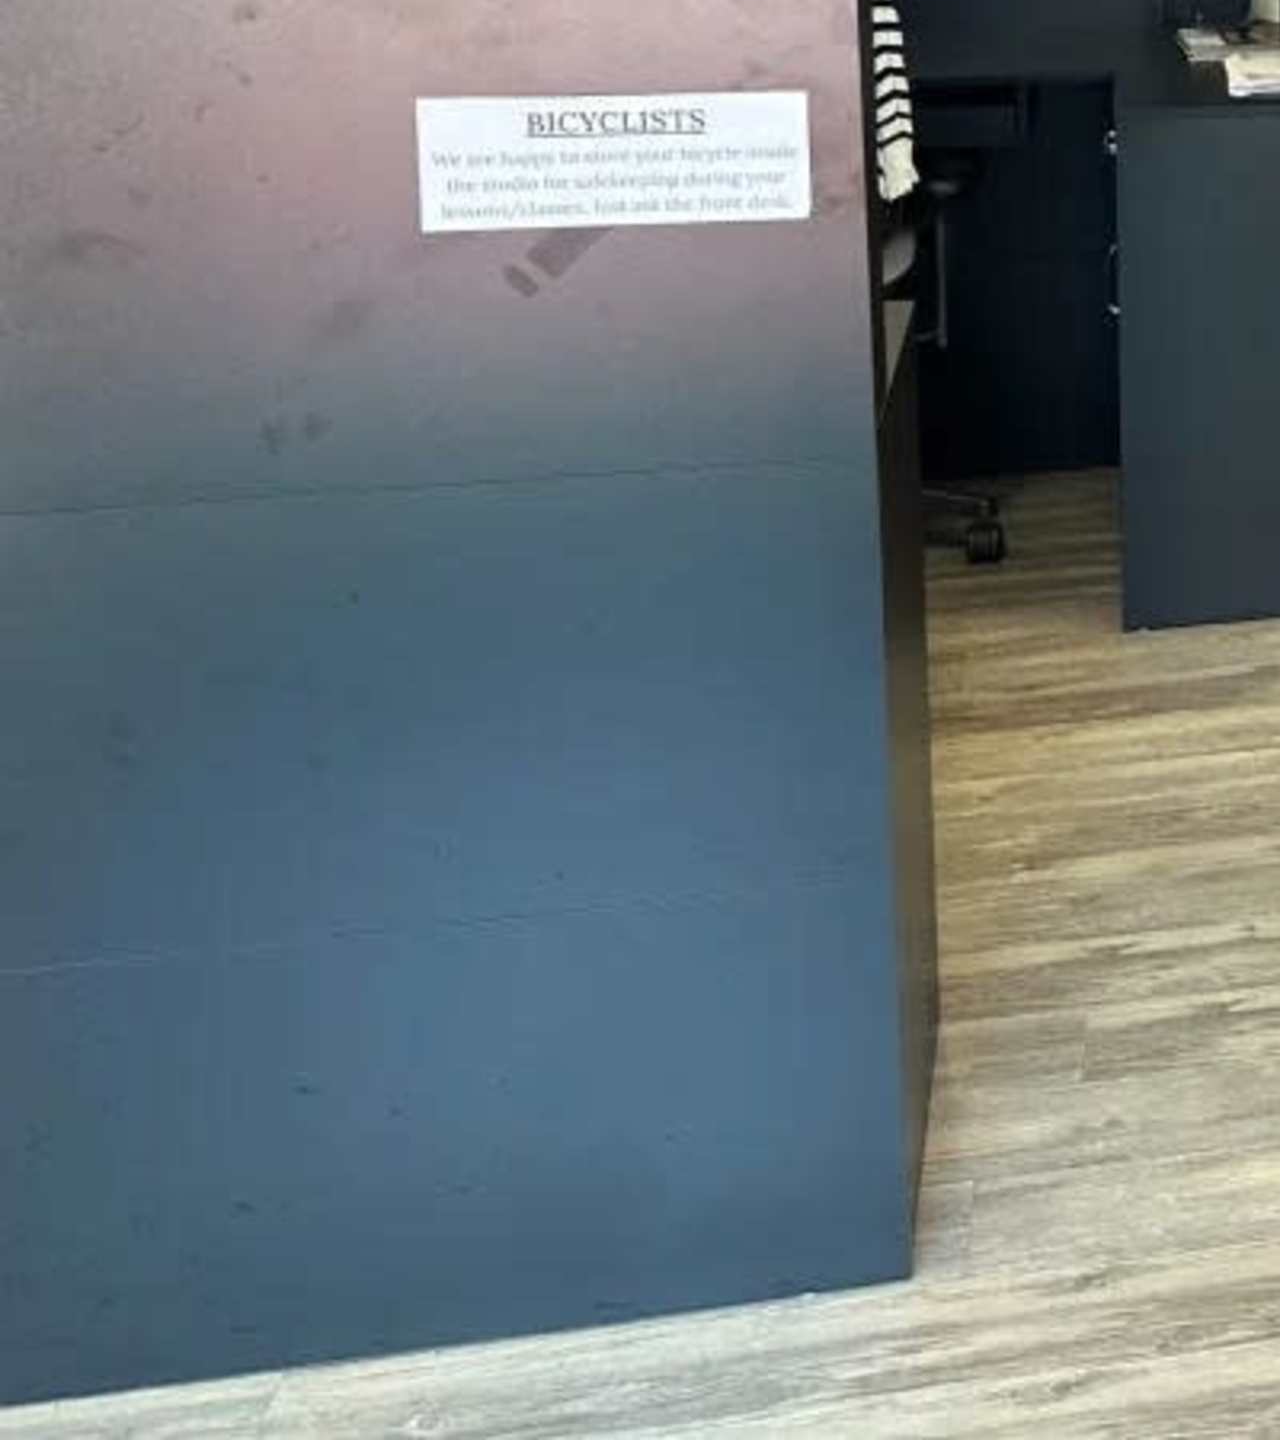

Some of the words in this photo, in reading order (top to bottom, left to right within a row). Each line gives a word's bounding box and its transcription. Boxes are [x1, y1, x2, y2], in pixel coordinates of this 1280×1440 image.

[526, 109, 705, 137] BICYCLISTS
[680, 146, 742, 164] bicycle
[574, 170, 679, 190] safekeeping
[684, 170, 743, 189] during
